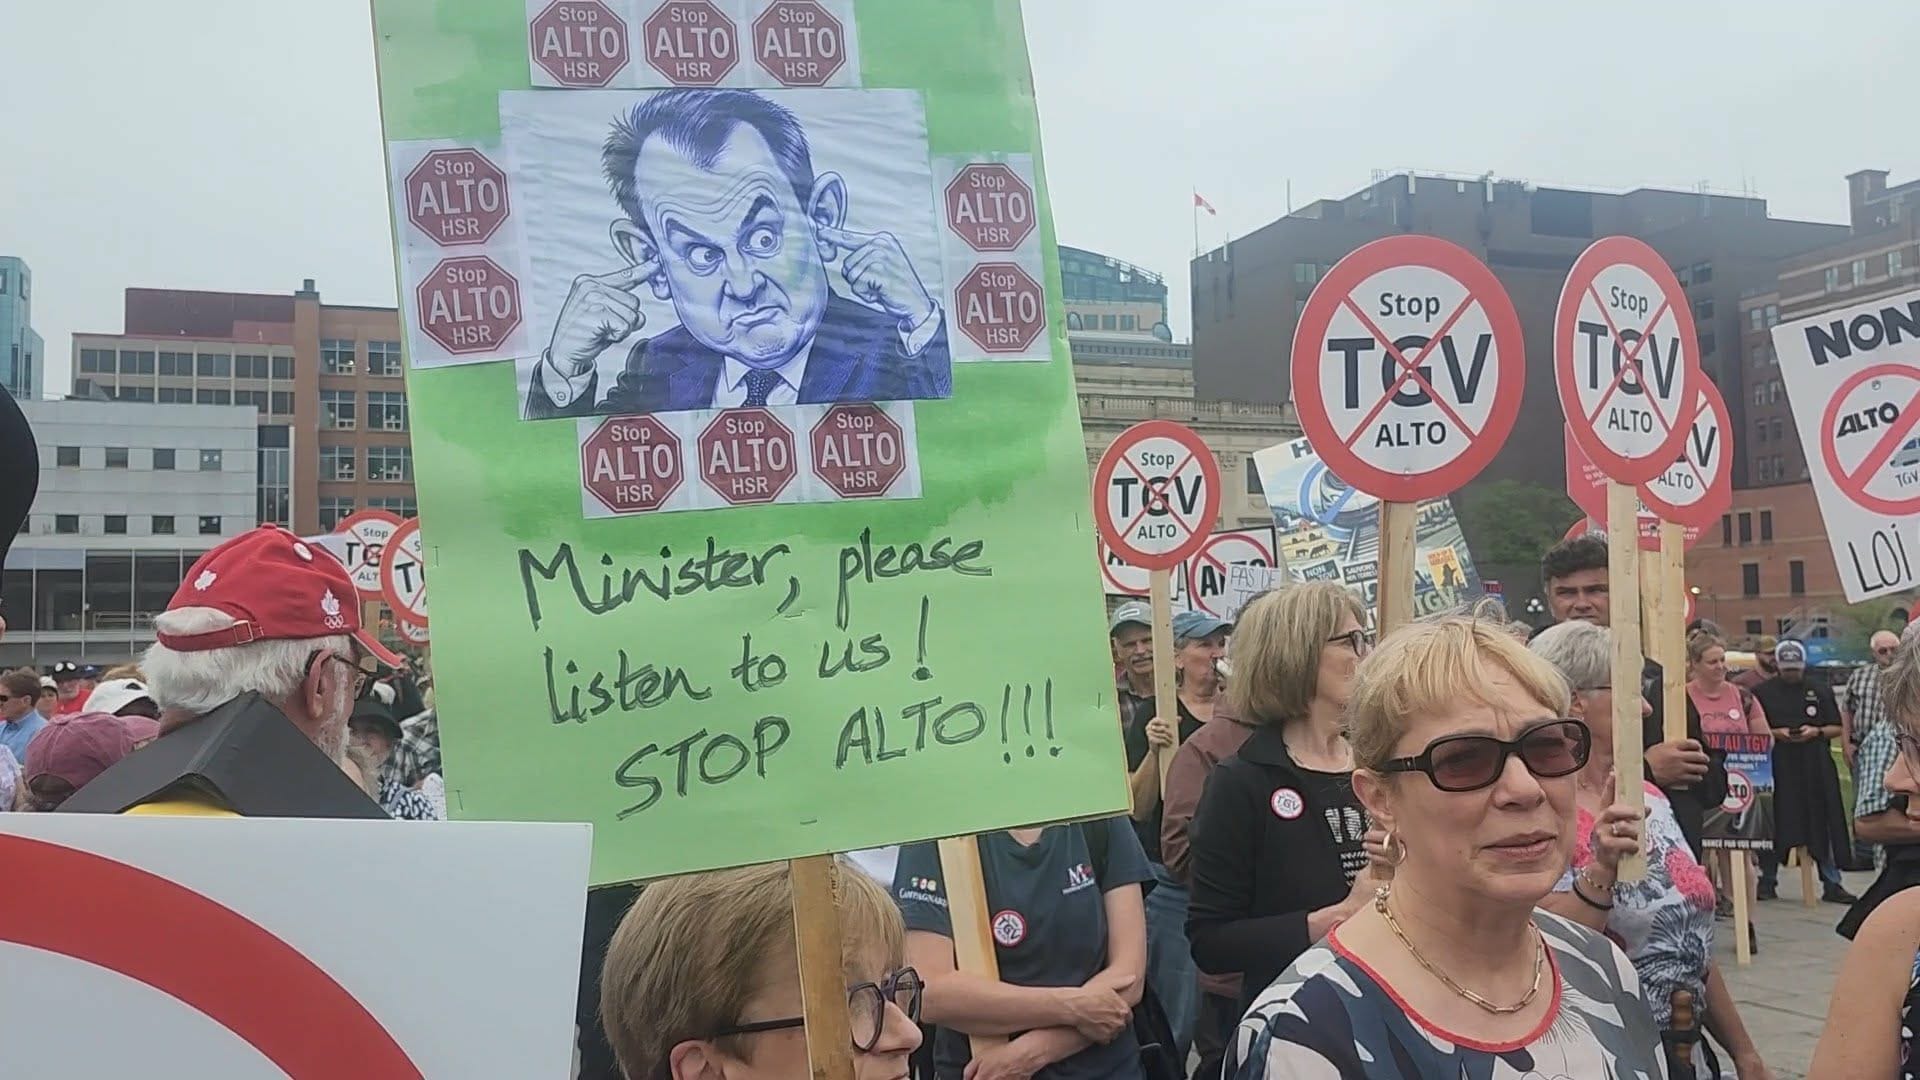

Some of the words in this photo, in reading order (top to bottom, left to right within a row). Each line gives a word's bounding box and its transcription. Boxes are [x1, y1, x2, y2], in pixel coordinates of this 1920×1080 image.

[559, 6, 598, 23] Stop
[671, 8, 708, 24] Stop
[779, 8, 815, 24] Stop
[541, 26, 620, 58] ALTO
[654, 27, 730, 58] ALTO
[763, 27, 836, 59] ALTO
[564, 62, 600, 78] HSR
[676, 62, 712, 78] HSR
[784, 63, 819, 78] HSR
[434, 159, 475, 177] Stop
[970, 172, 1005, 191] Stop
[418, 177, 499, 217] ALTO
[955, 191, 1026, 224] ALTO
[441, 218, 480, 236] HSR
[976, 227, 1010, 243] HSR
[446, 267, 487, 285] Stop
[980, 272, 1015, 290] Stop
[429, 285, 511, 325] ALTO
[965, 291, 1037, 324] ALTO
[1379, 292, 1441, 323] Stop
[1610, 285, 1649, 321] Stop
[453, 325, 492, 345] HSR
[986, 328, 1020, 344] HSR
[1804, 300, 1920, 367] NON
[1578, 320, 1680, 400] TGV
[1326, 333, 1492, 410] TGV
[726, 418, 765, 437] Stop
[836, 413, 874, 431] Stop
[1607, 407, 1653, 434] ALTO
[1836, 402, 1900, 439] ALTO
[611, 424, 651, 444] Stop
[1374, 421, 1447, 448] ALTO
[709, 437, 787, 475] ALTO
[821, 432, 897, 469] ALTO
[592, 444, 675, 483] ALTO
[1141, 452, 1175, 470] Stop
[732, 476, 769, 495] HSR
[843, 471, 878, 488] HSR
[1658, 472, 1694, 489] ALTO
[1895, 469, 1919, 487] TGV
[615, 484, 654, 504] HSR
[1112, 475, 1203, 518] TGV
[363, 527, 388, 539] Stop
[1137, 524, 1177, 540] ALTO
[346, 543, 382, 566] TG
[357, 571, 378, 581] ALT
[518, 537, 801, 632] Minister,
[838, 527, 993, 630] please
[1231, 566, 1254, 588] PAS
[543, 643, 711, 725] listen
[732, 632, 787, 691] to
[615, 715, 790, 821] STOP
[834, 677, 1064, 769] ALTO!!!
[1745, 735, 1769, 752] TGV
[1728, 784, 1748, 798] LTO
